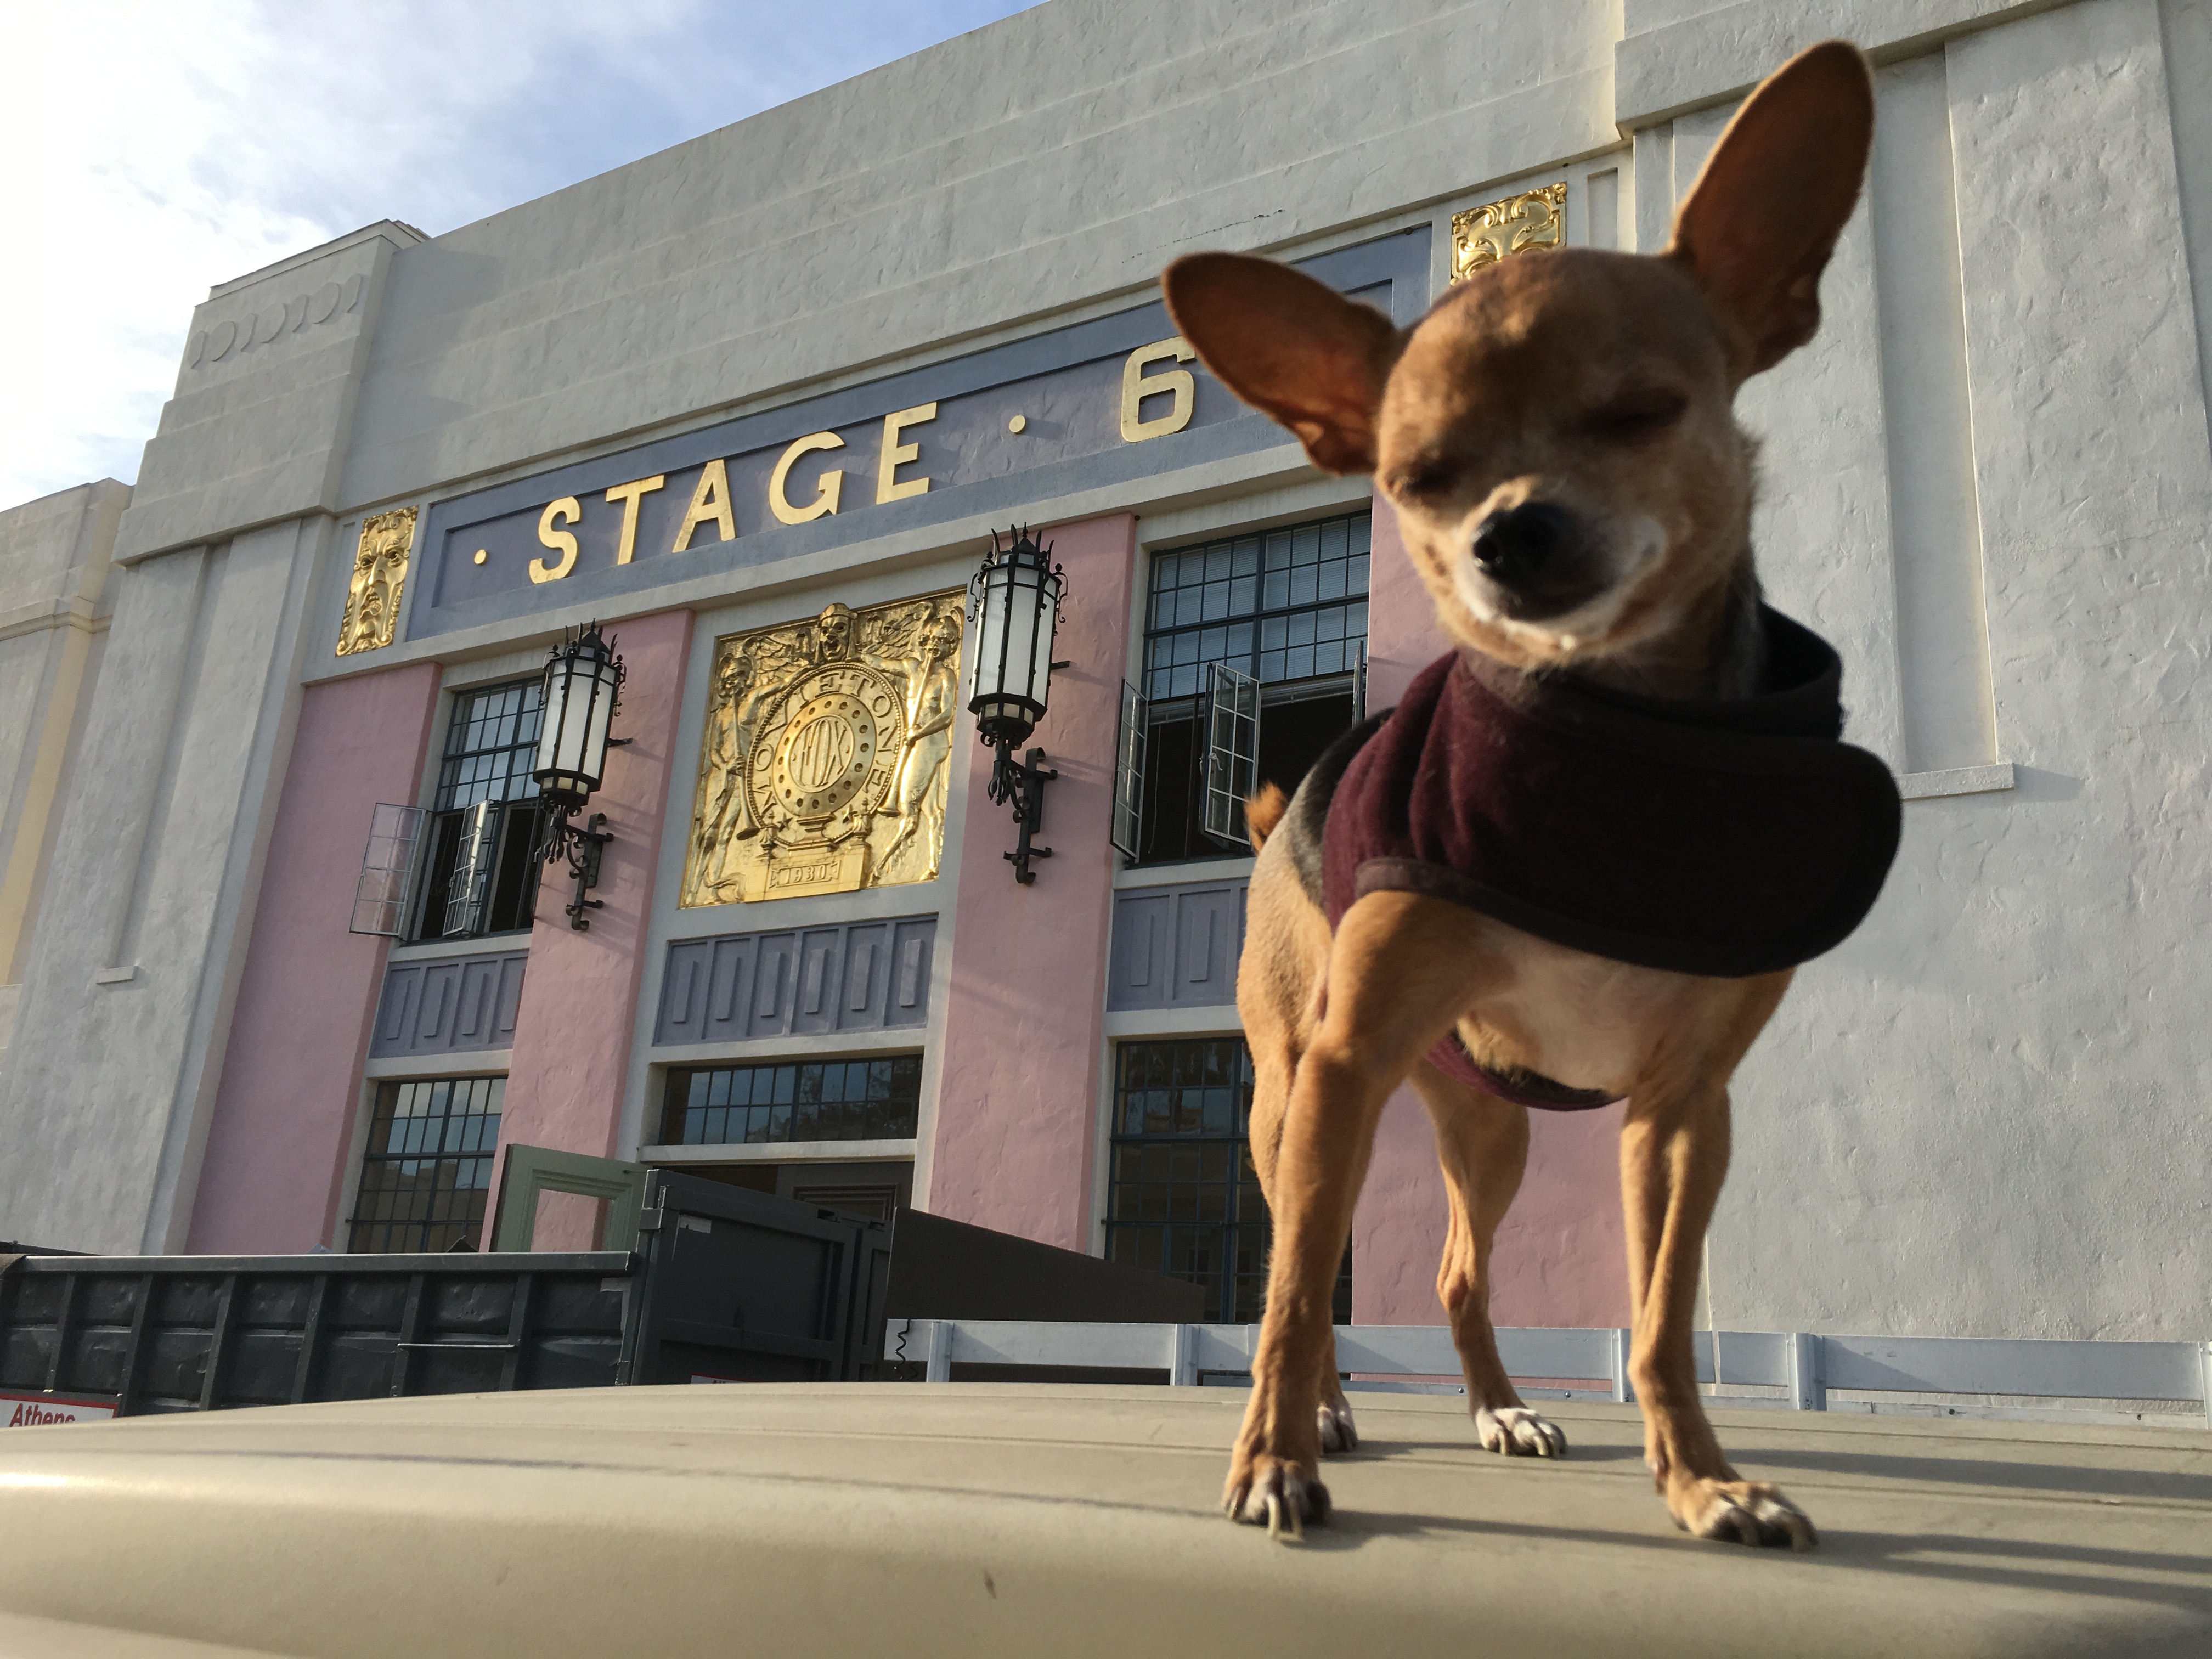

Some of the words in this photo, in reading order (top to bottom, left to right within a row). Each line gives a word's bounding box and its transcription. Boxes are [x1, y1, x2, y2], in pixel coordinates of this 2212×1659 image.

[529, 403, 937, 583] STAGE
[1121, 336, 1195, 442] 6
[795, 718, 847, 787] FOX
[781, 865, 826, 884] 1930
